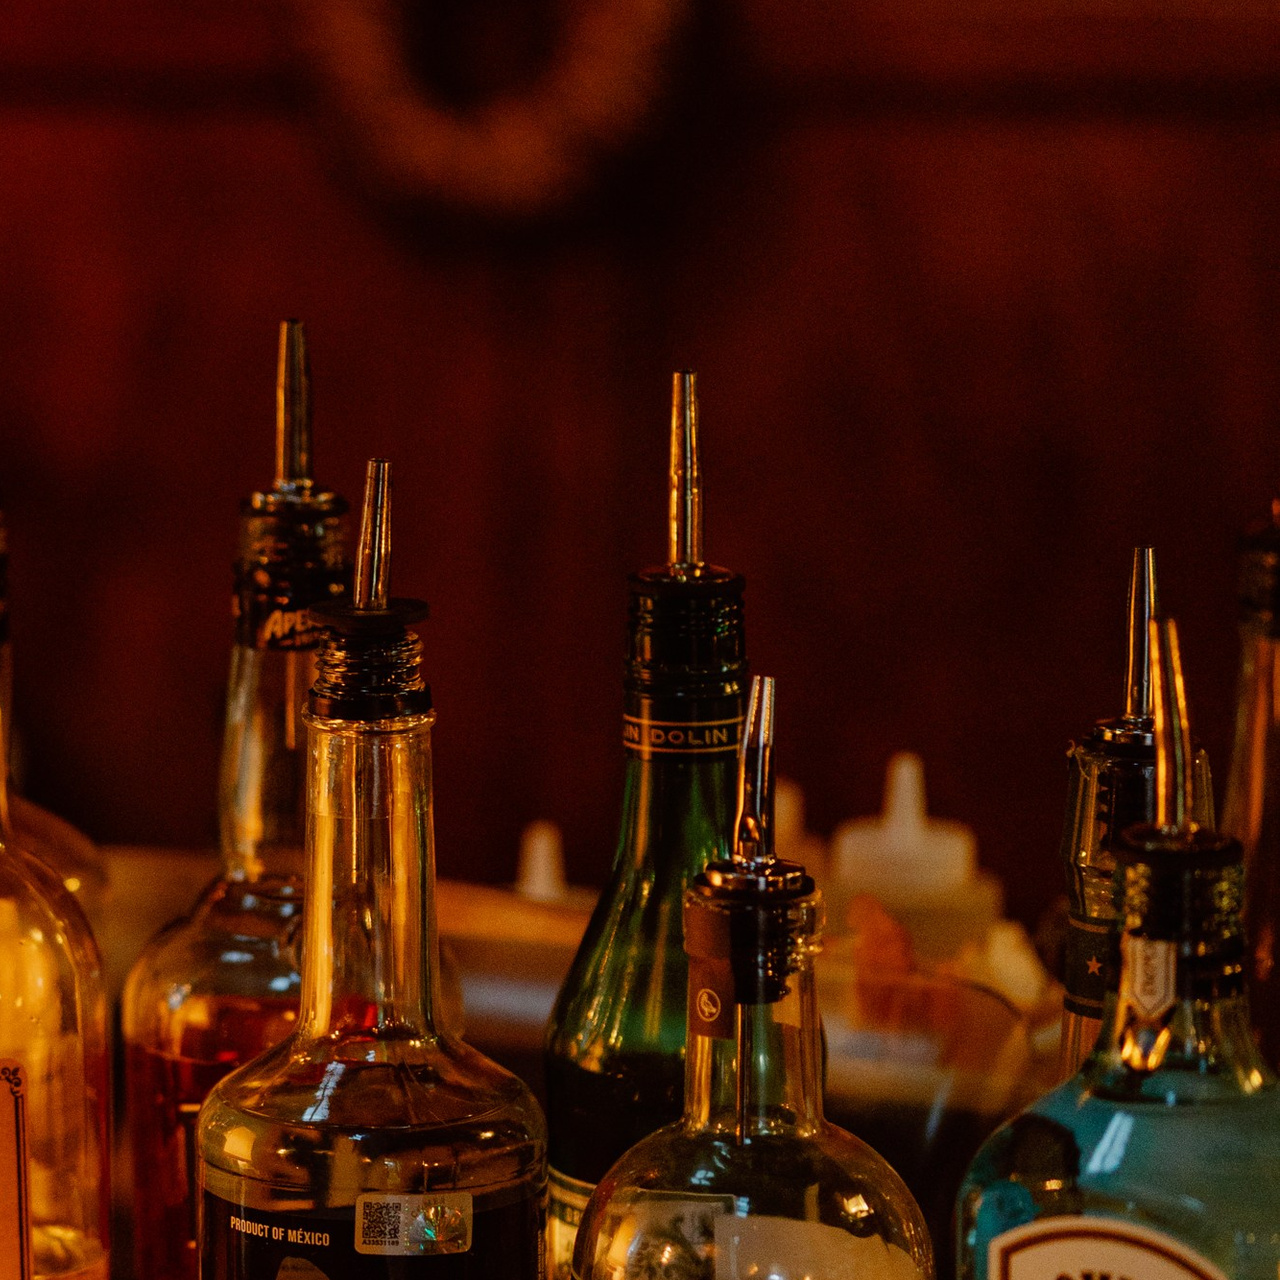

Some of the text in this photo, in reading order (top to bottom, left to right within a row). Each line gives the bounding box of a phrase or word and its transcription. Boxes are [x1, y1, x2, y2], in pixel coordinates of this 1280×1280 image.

[651, 727, 728, 745] DOLIN
[230, 1216, 330, 1246] PRODUCT OF MÉXICO
